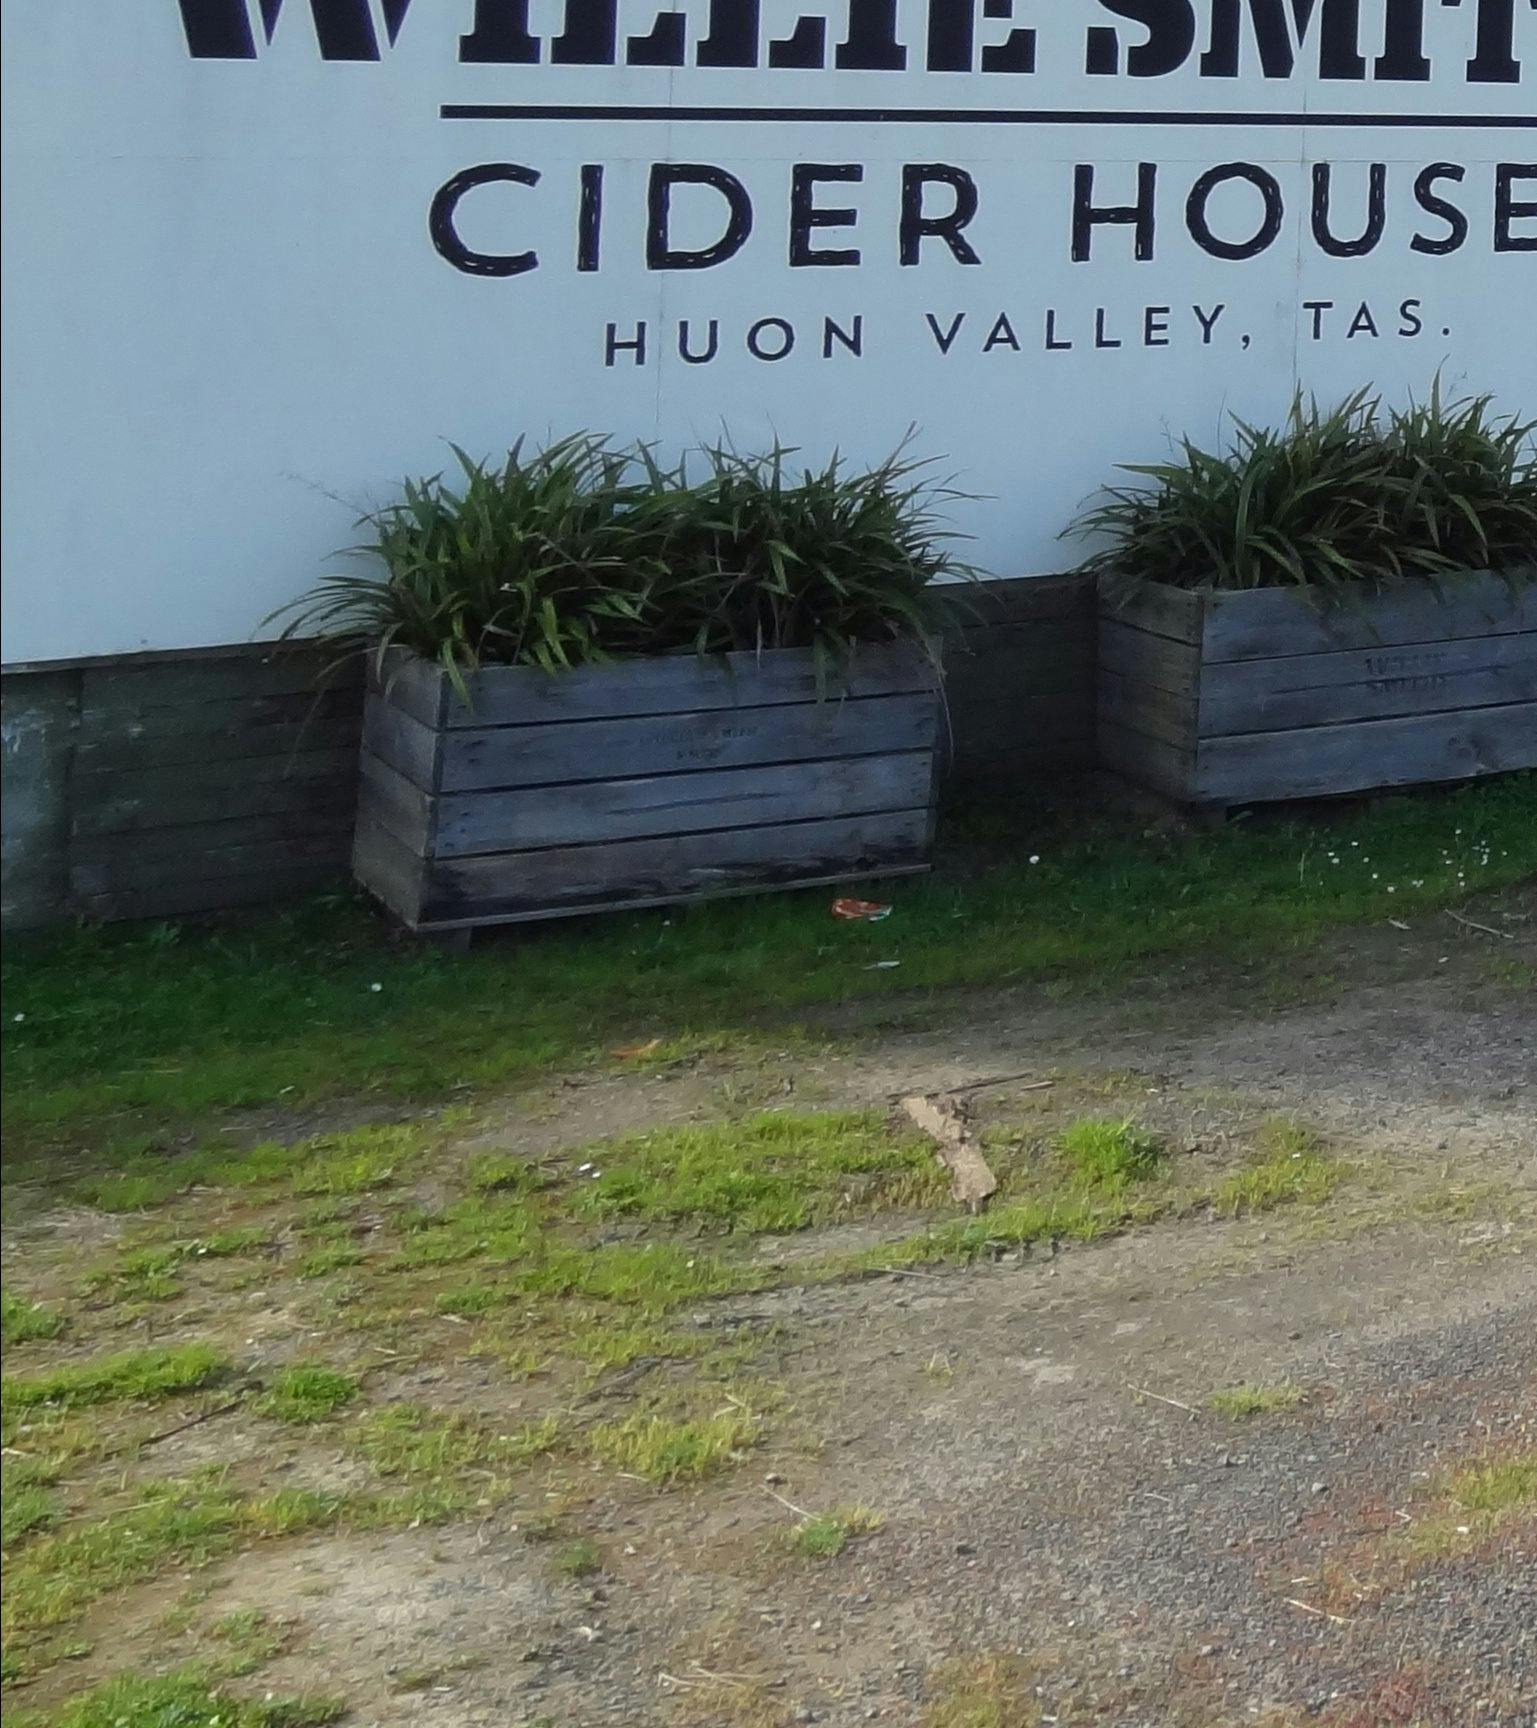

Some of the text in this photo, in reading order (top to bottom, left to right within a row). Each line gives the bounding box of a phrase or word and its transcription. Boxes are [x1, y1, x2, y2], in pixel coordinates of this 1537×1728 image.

[428, 162, 982, 278] CIDER
[605, 298, 1451, 368] HUON VALLEY, TAS.
